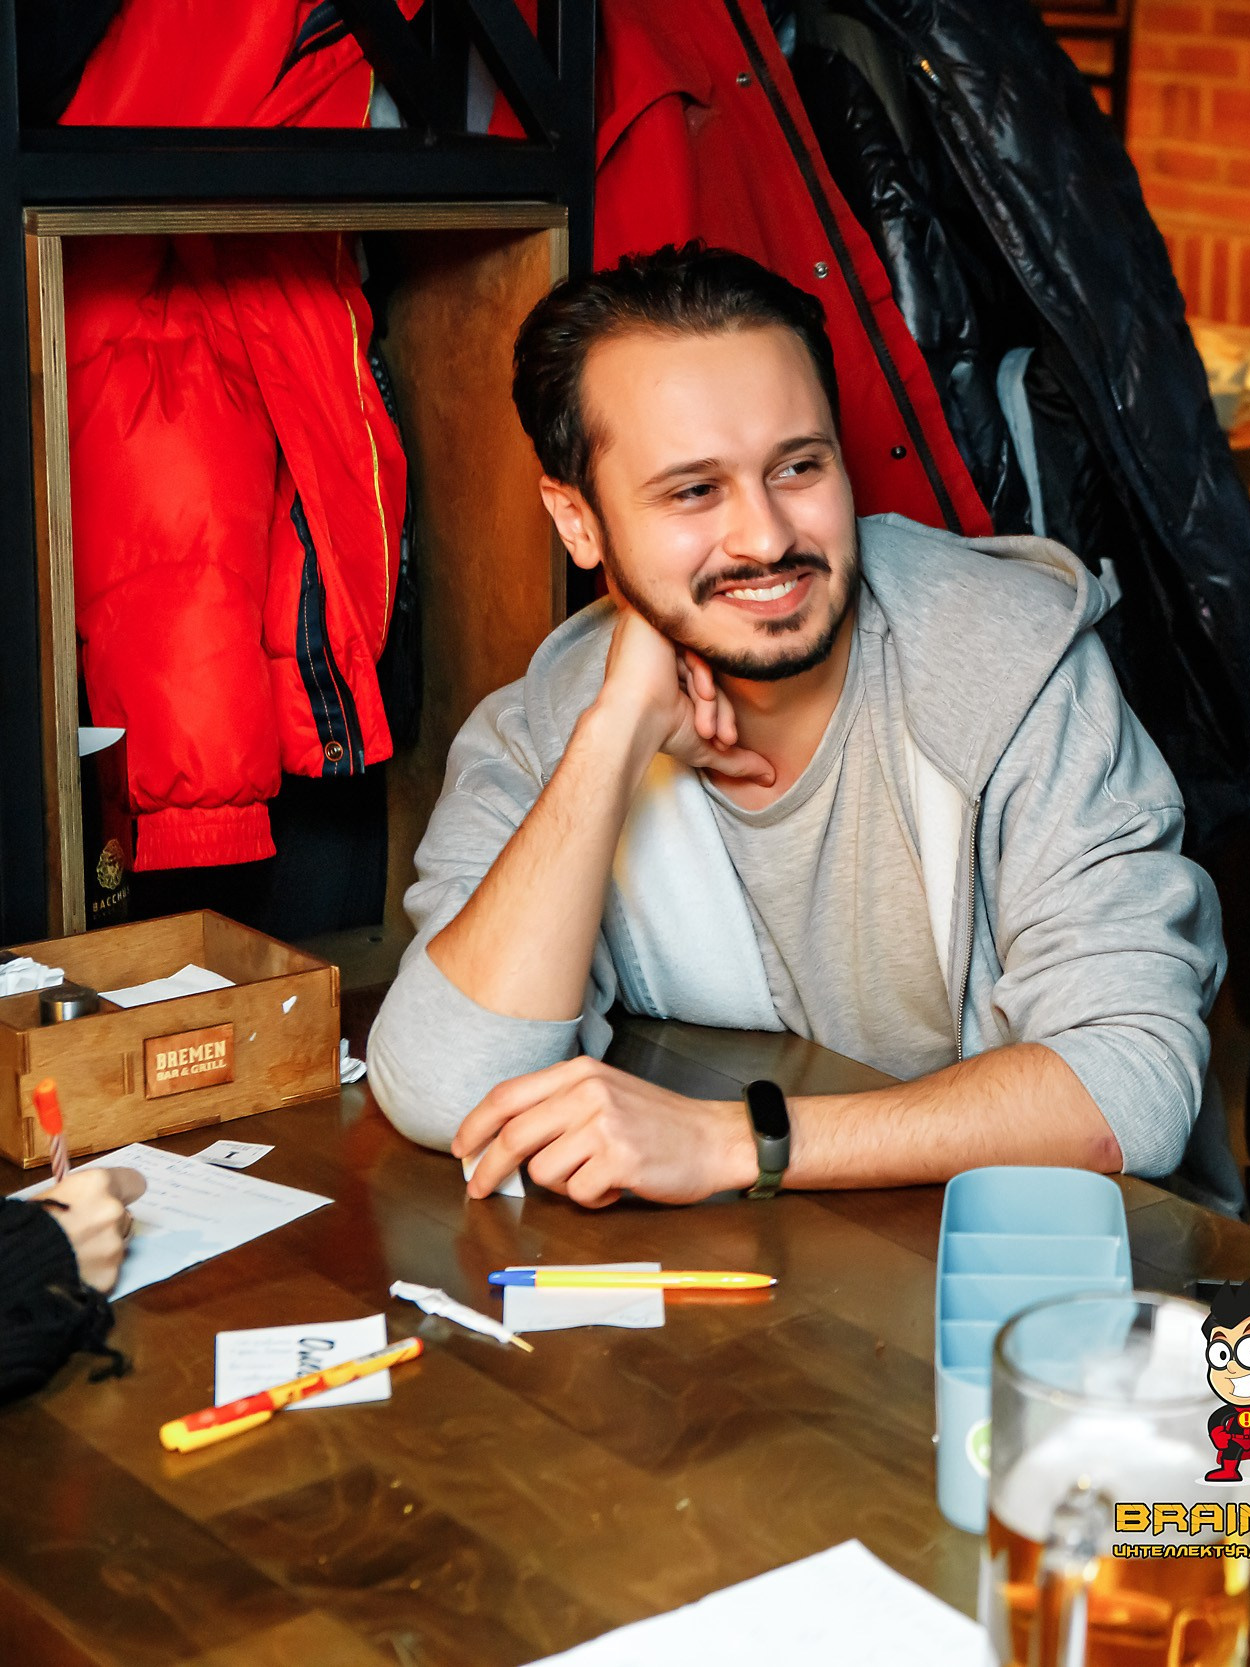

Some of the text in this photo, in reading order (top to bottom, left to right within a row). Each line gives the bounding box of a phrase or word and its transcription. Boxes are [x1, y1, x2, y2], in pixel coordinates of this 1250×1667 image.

[156, 1040, 226, 1071] BREMEN
[156, 1059, 227, 1082] BAR & GRILL
